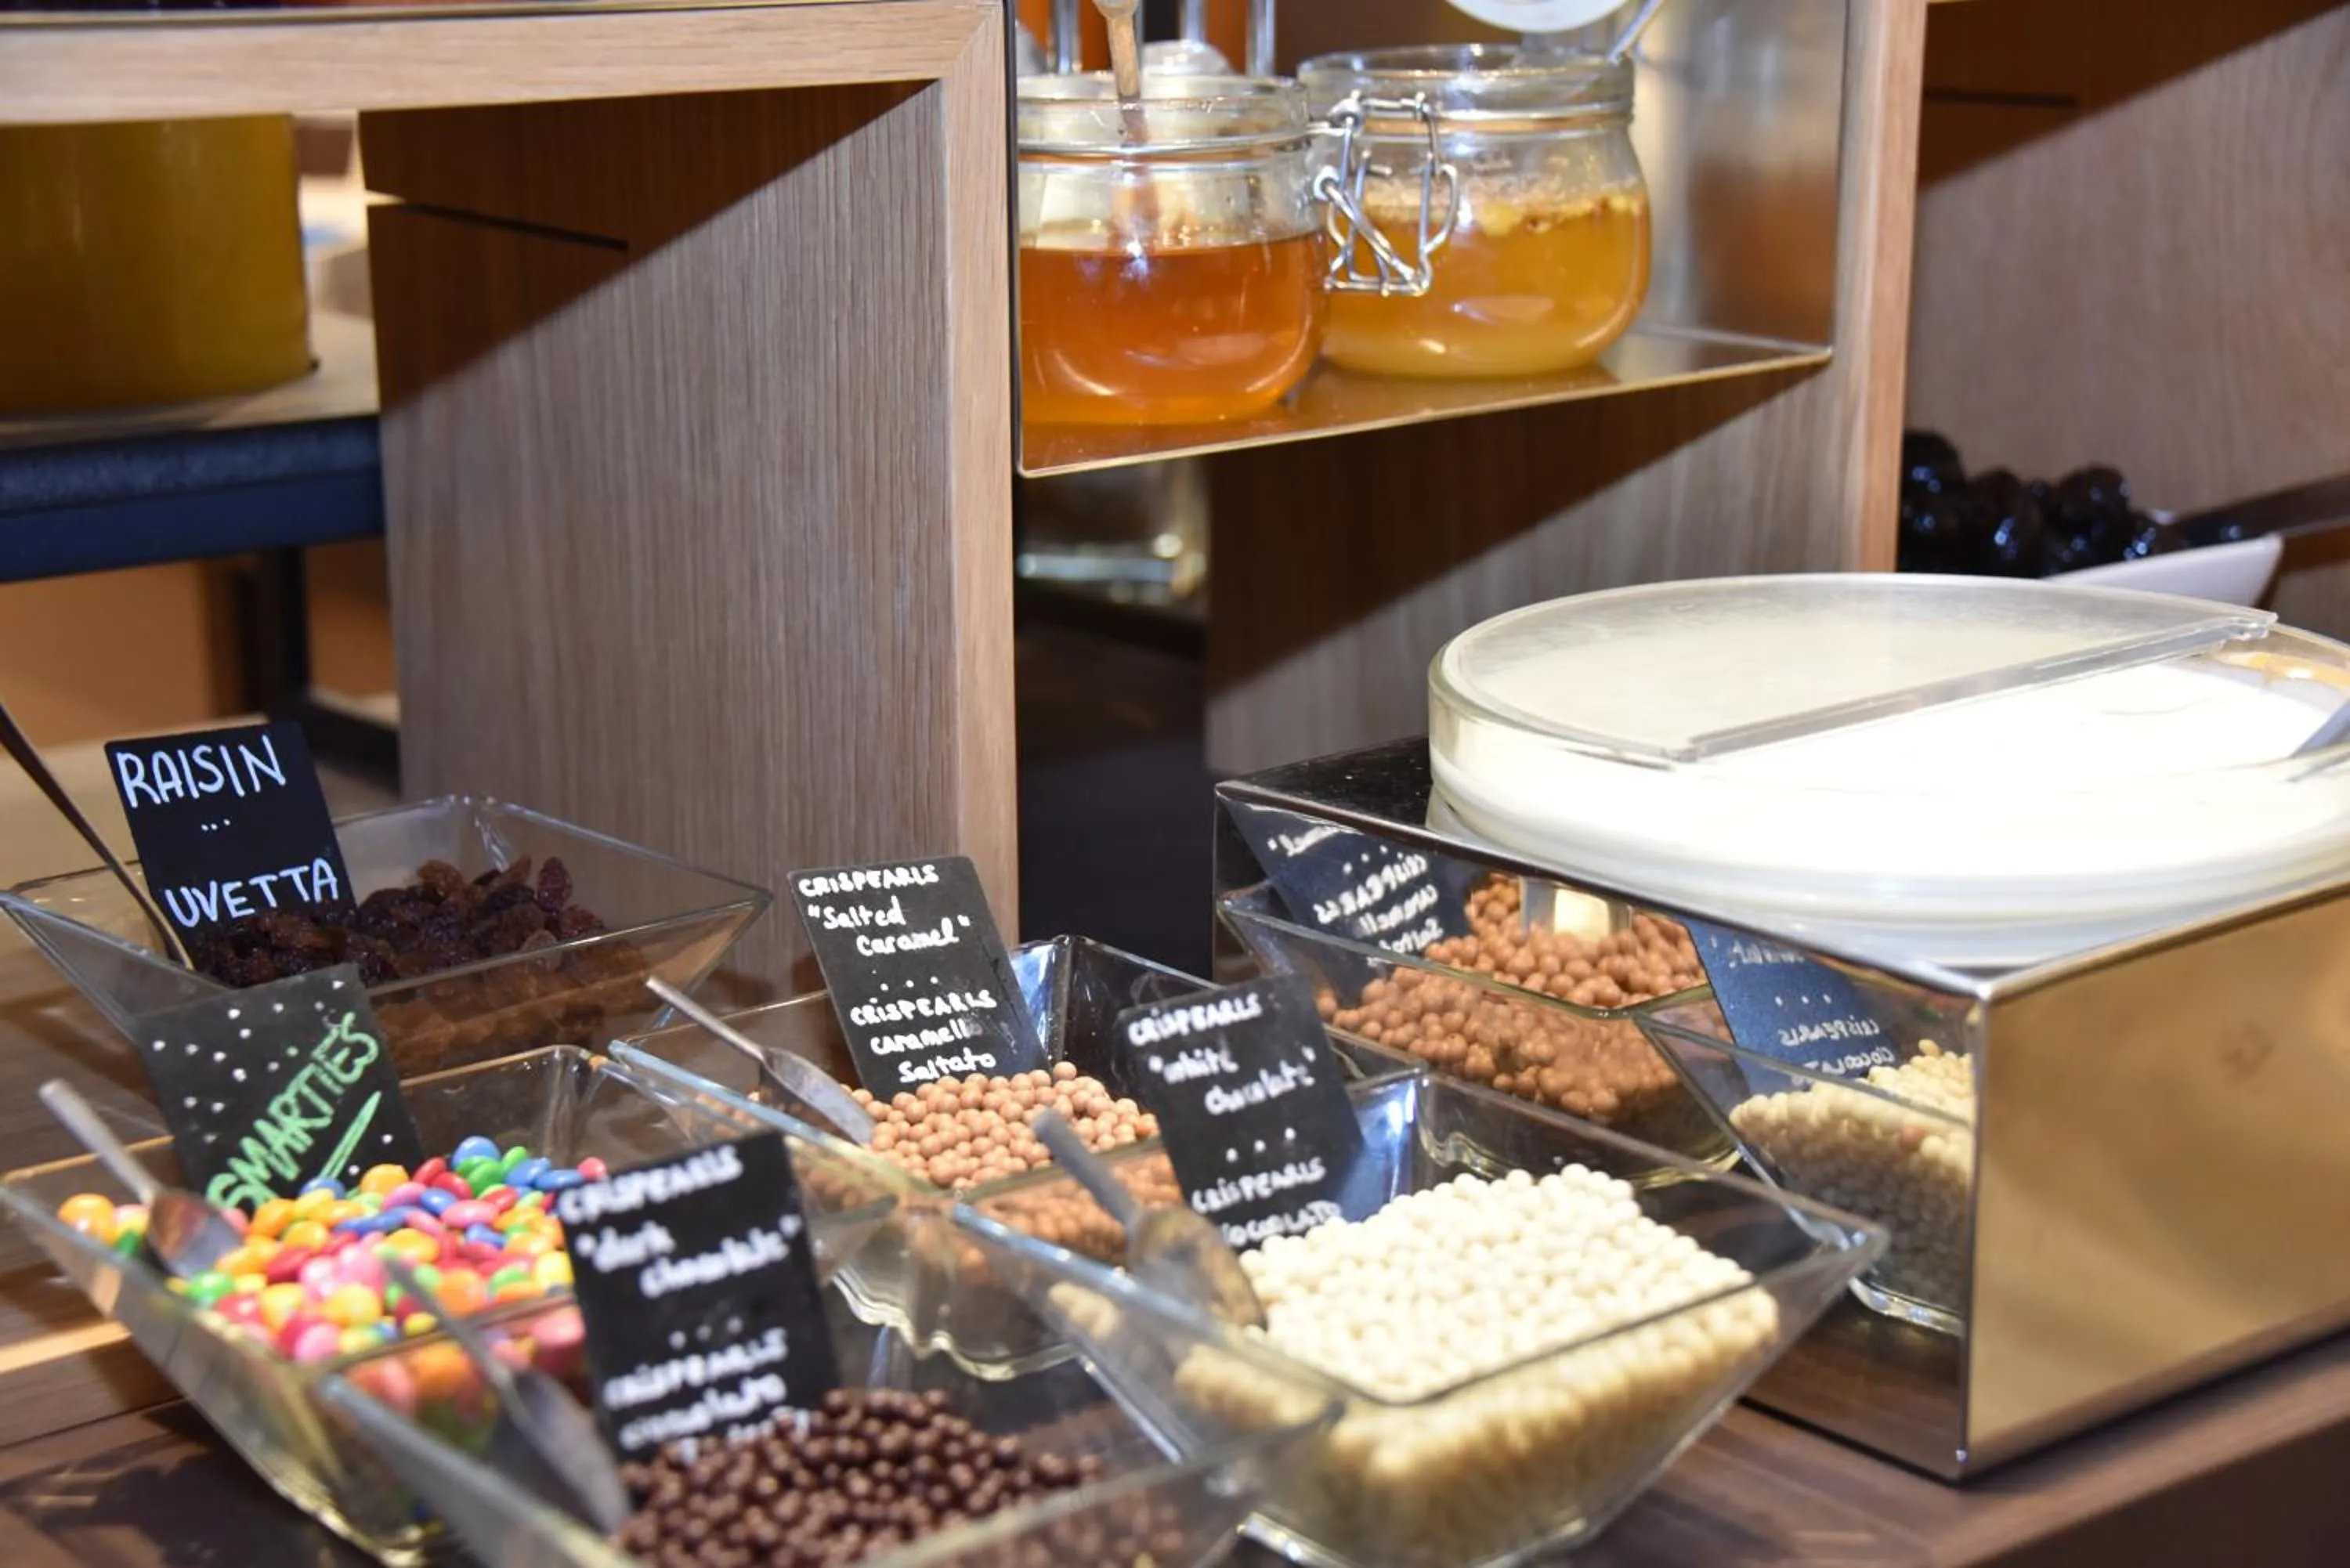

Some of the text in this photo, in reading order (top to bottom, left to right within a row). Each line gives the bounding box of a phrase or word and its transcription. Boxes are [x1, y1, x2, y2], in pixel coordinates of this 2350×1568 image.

[116, 735, 287, 808] RAISIN
[164, 858, 338, 927] UVETTA
[798, 864, 939, 897] CRISPEARLS
[851, 989, 997, 1027] CRISPEARLS
[205, 1012, 380, 1209] SMARTIES
